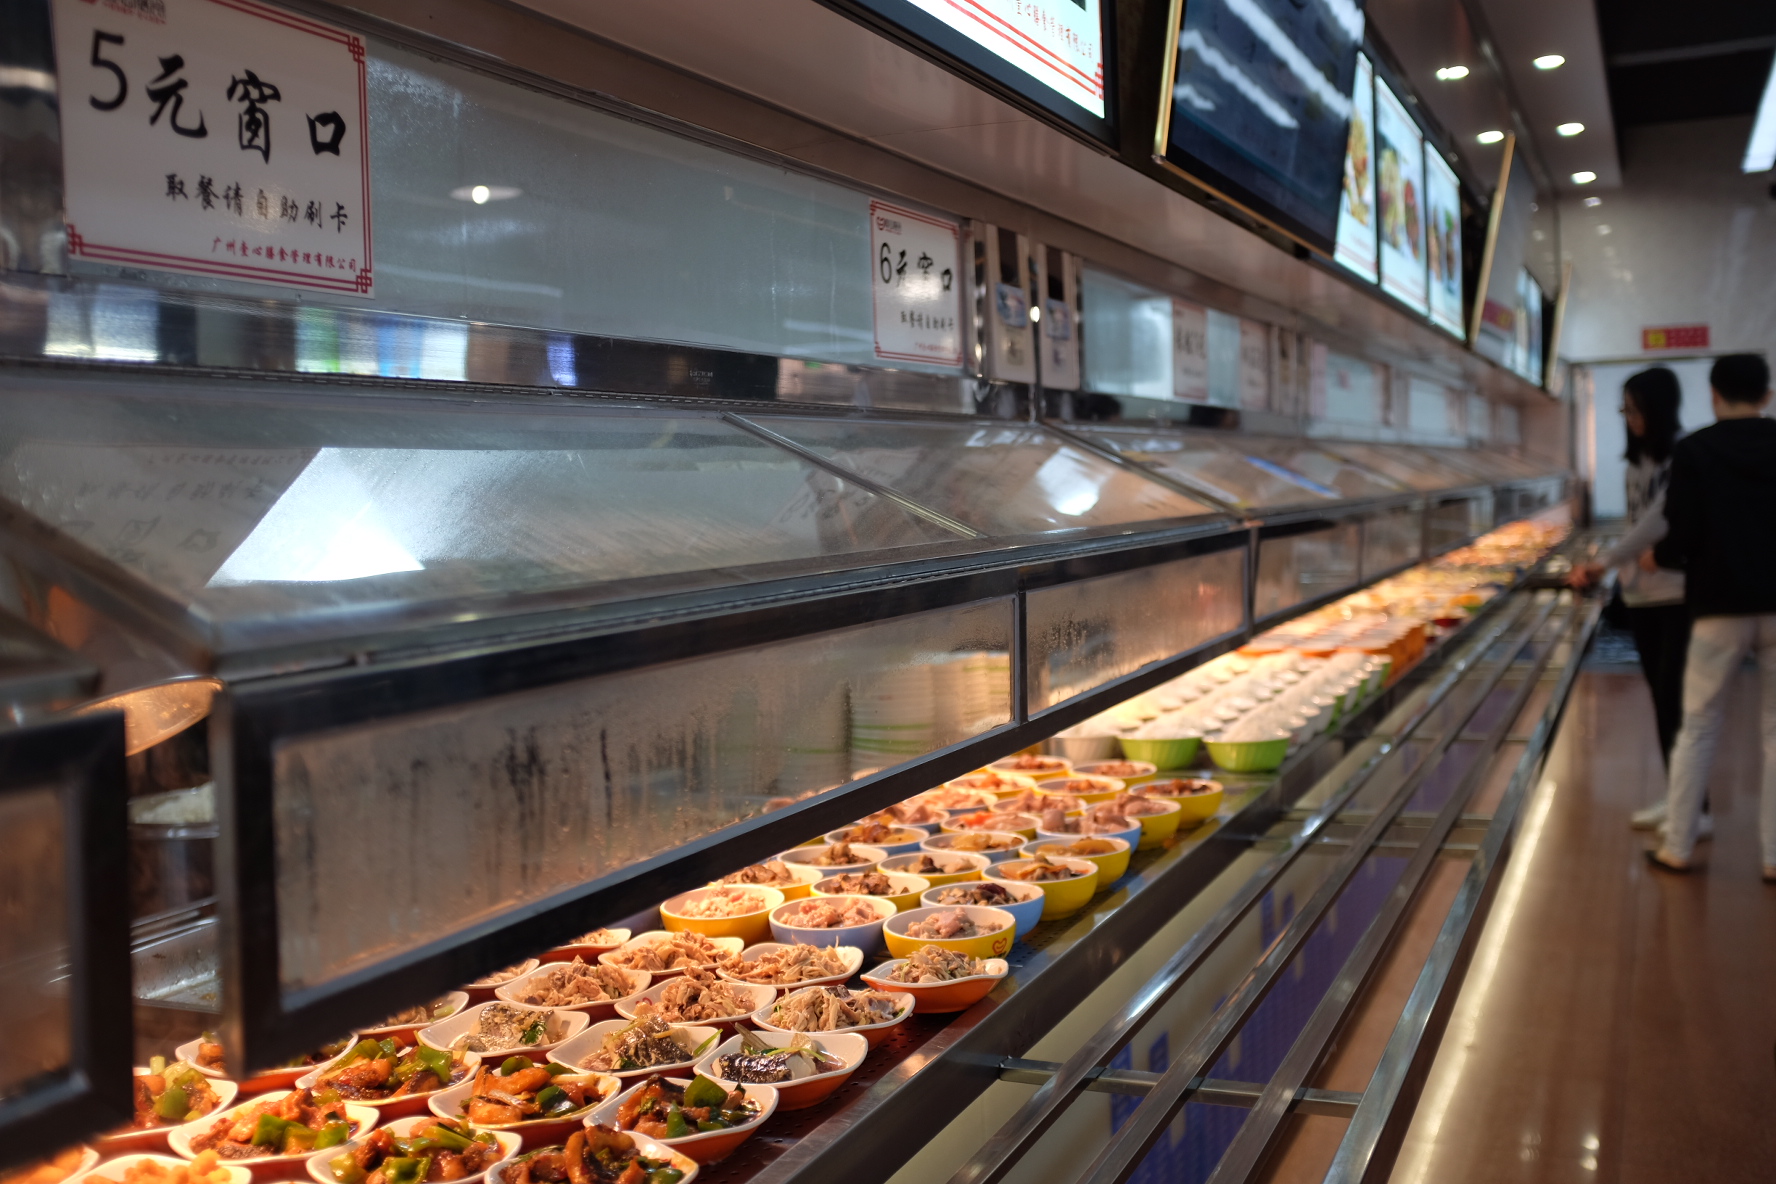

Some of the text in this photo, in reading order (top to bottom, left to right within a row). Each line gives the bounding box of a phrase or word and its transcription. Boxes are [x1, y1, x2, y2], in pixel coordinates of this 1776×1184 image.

[88, 29, 346, 165] 5元窗口
[165, 173, 348, 233] 取餐请自助刷卡
